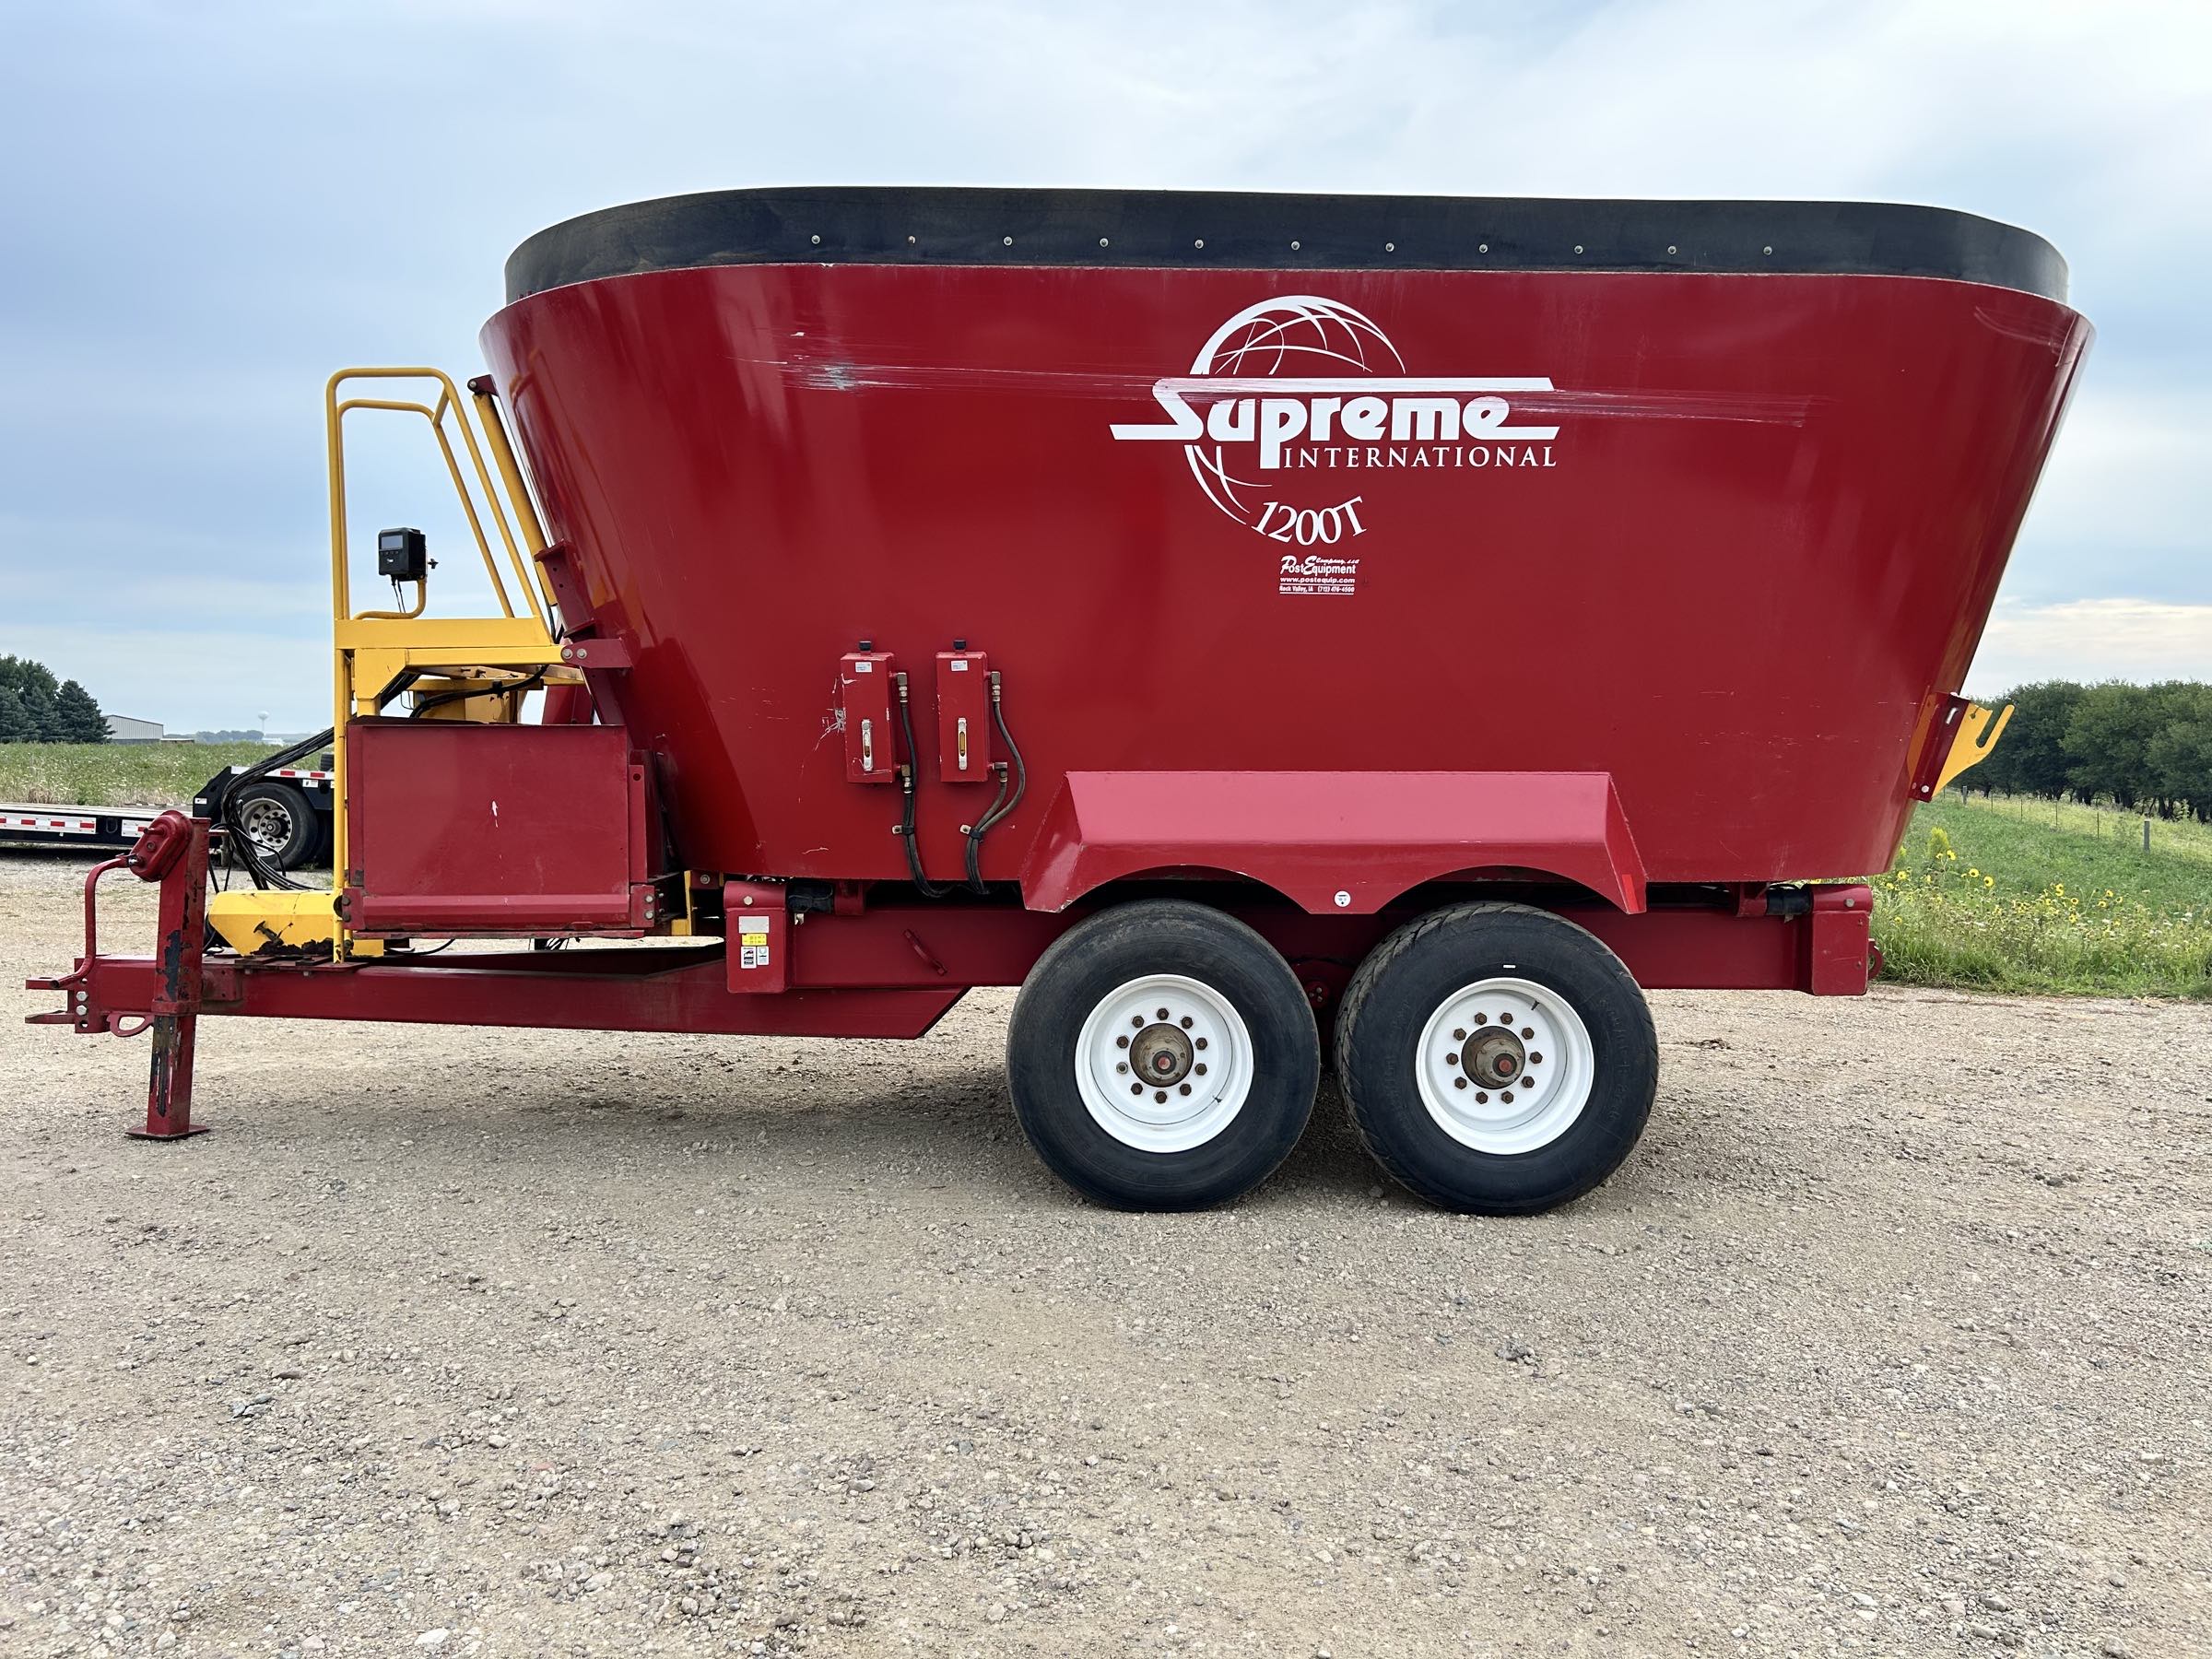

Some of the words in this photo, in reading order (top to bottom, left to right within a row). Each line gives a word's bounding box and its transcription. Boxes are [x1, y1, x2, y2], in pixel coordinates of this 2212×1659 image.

[1110, 377, 1559, 469] Supreme
[1283, 445, 1557, 467] INTERNATIONAL
[1252, 496, 1367, 545] 1200T
